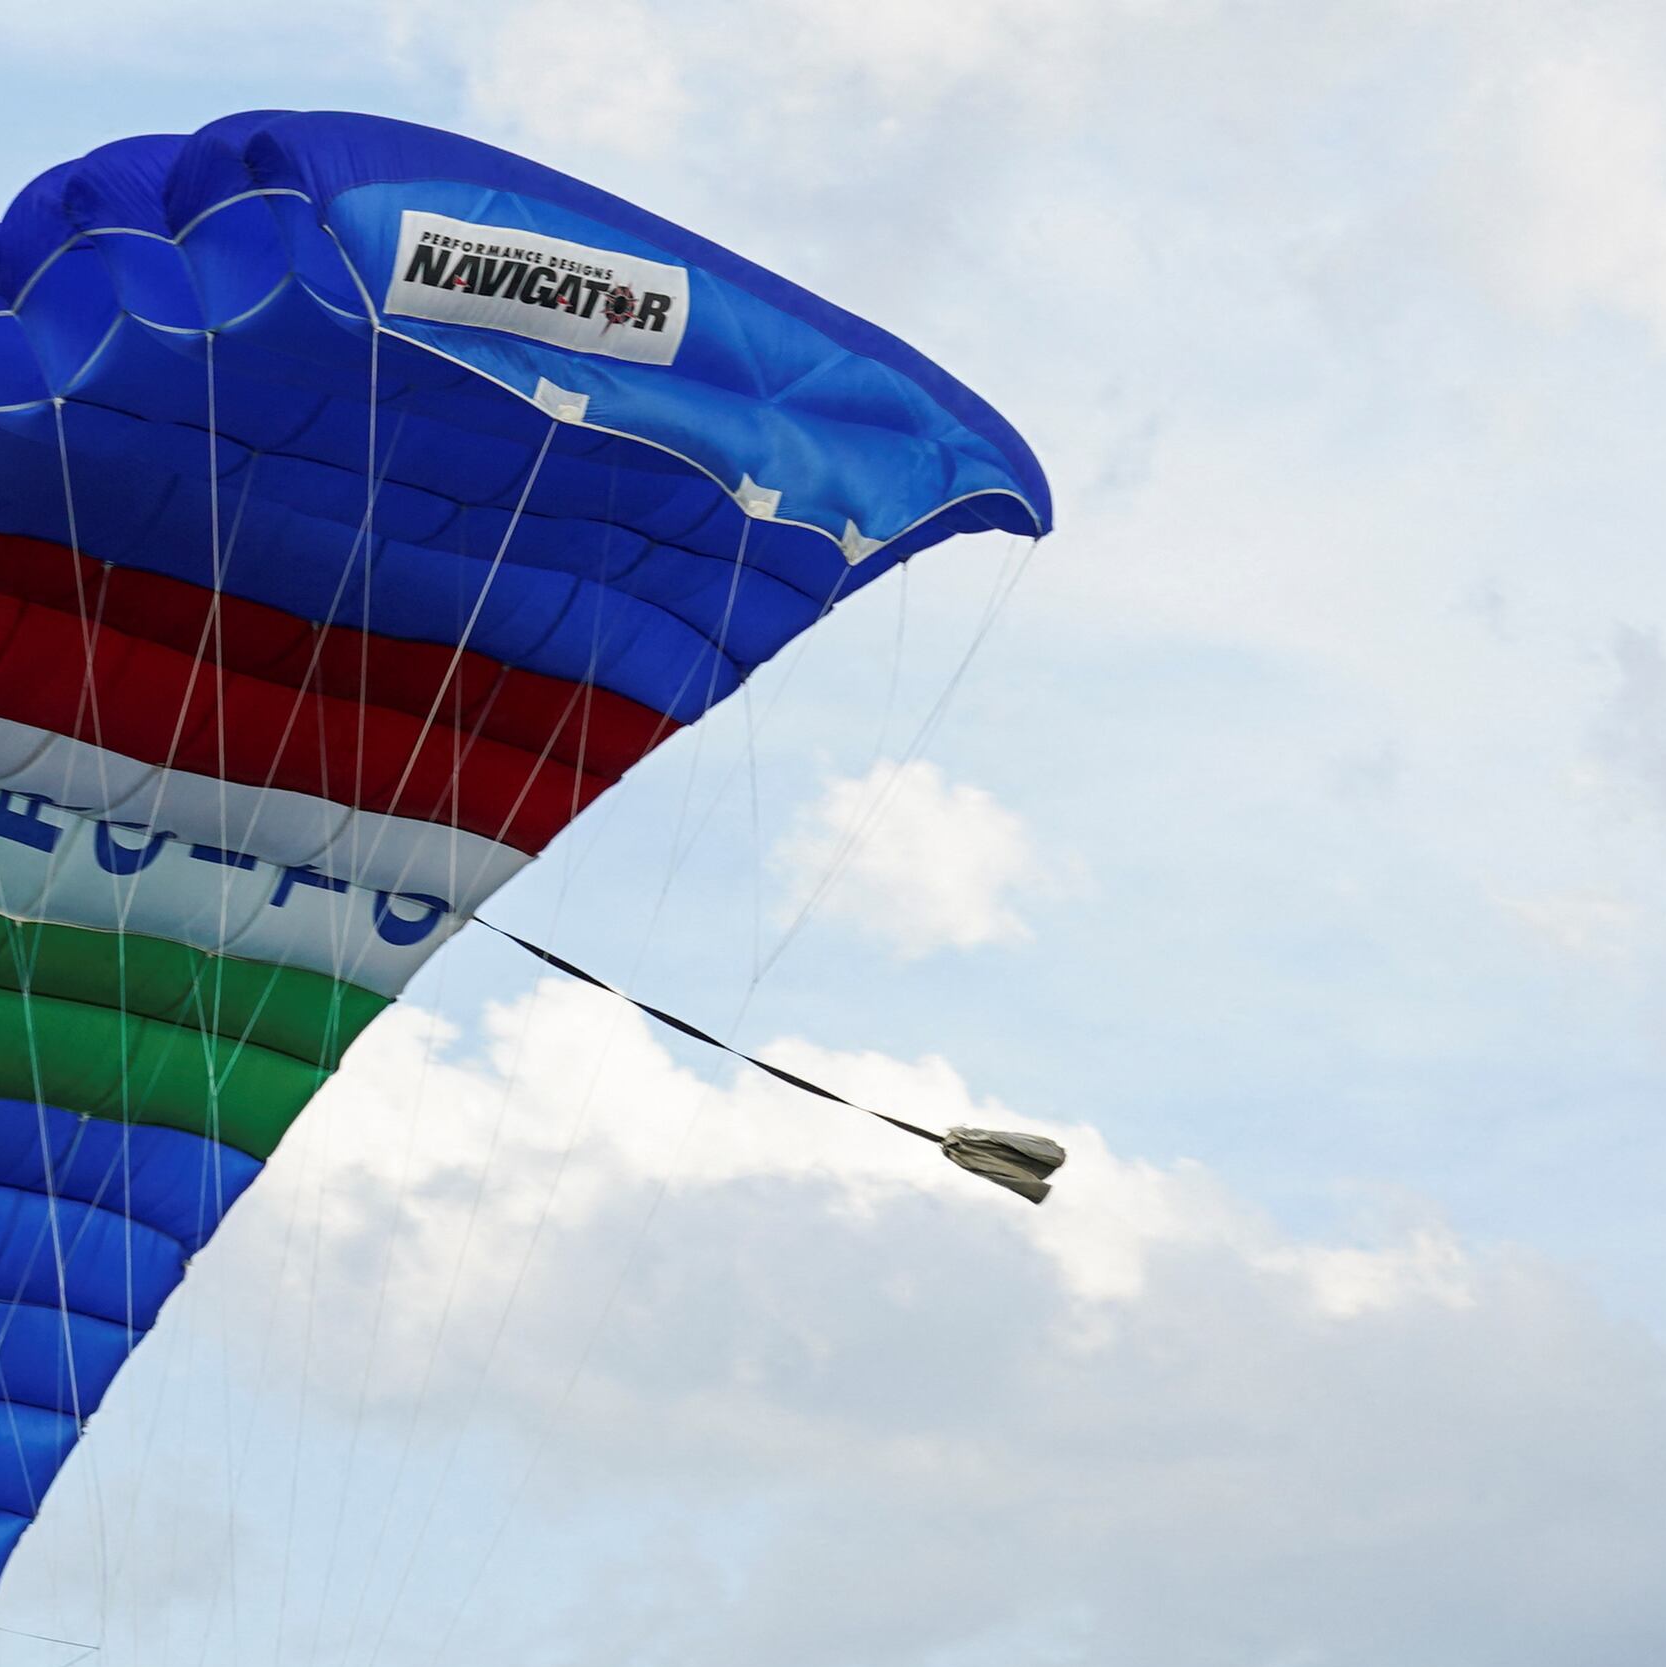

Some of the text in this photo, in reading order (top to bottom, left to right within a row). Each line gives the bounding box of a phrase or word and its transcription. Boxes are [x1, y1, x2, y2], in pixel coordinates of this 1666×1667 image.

[403, 243, 672, 333] NAVIGATOR
[420, 230, 614, 280] PERFORMANCE DESIGNS
